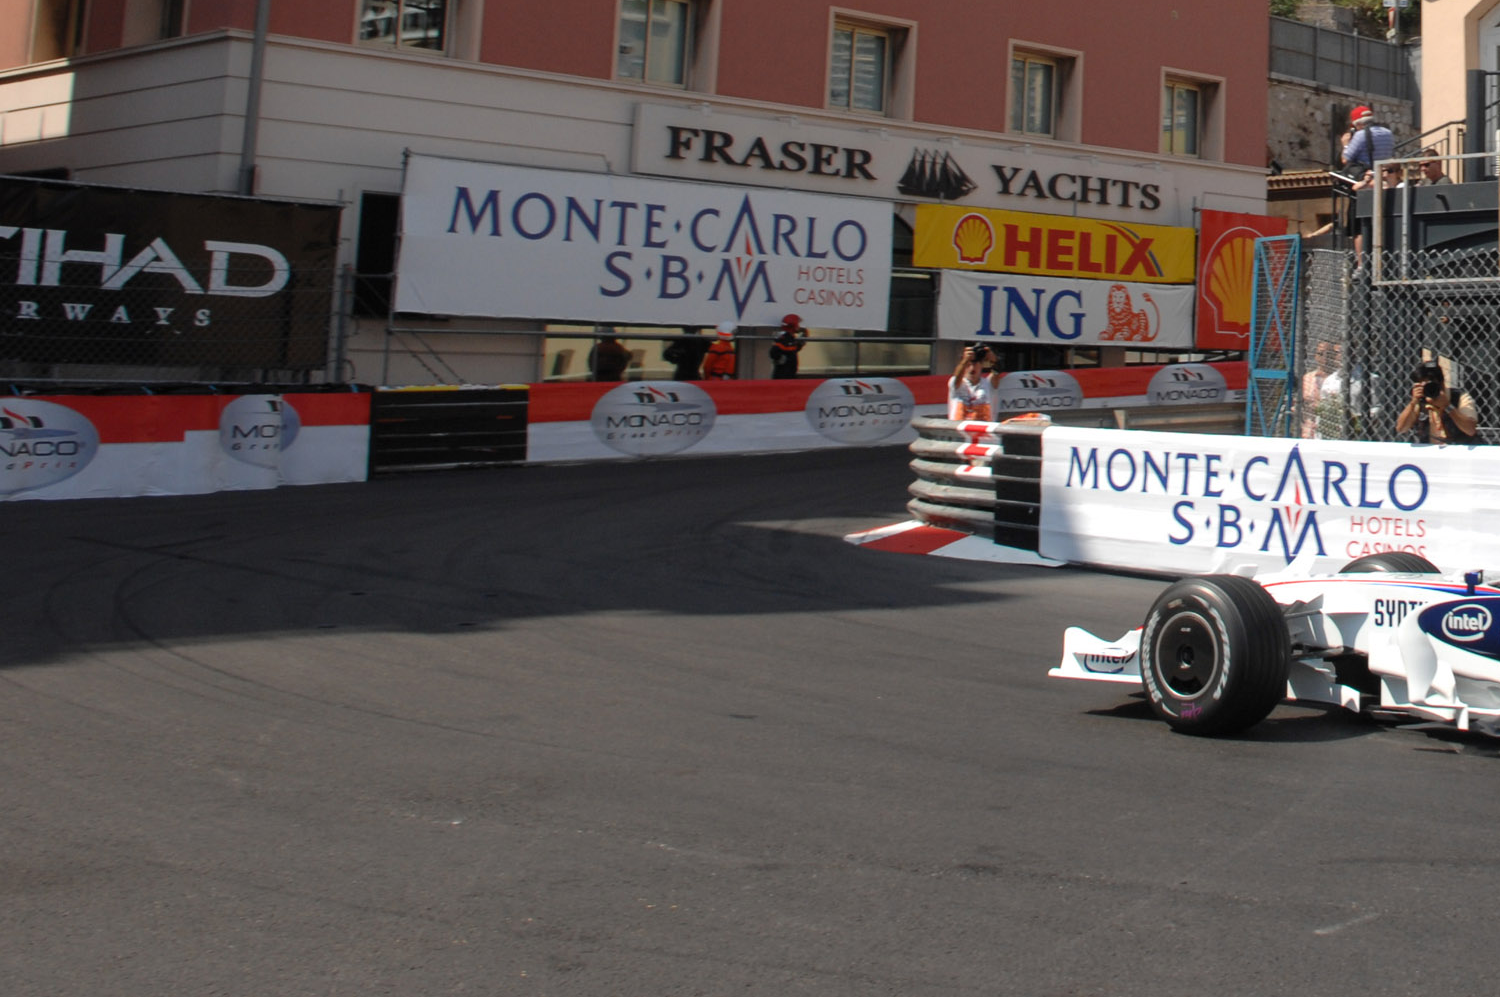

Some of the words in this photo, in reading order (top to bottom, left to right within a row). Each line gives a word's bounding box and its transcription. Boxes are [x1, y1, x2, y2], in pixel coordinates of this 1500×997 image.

[665, 125, 878, 181] FRASER
[991, 164, 1162, 210] YACHTS
[1003, 222, 1160, 276] HELIX
[797, 265, 865, 285] HOTELS
[794, 287, 865, 308] CASINOS
[977, 285, 1087, 340] ING
[1156, 390, 1218, 402] MONACO
[818, 403, 902, 418] MONACO
[606, 413, 703, 429] MONACO
[1350, 515, 1426, 538] HOTELS
[1448, 611, 1485, 631] intel
